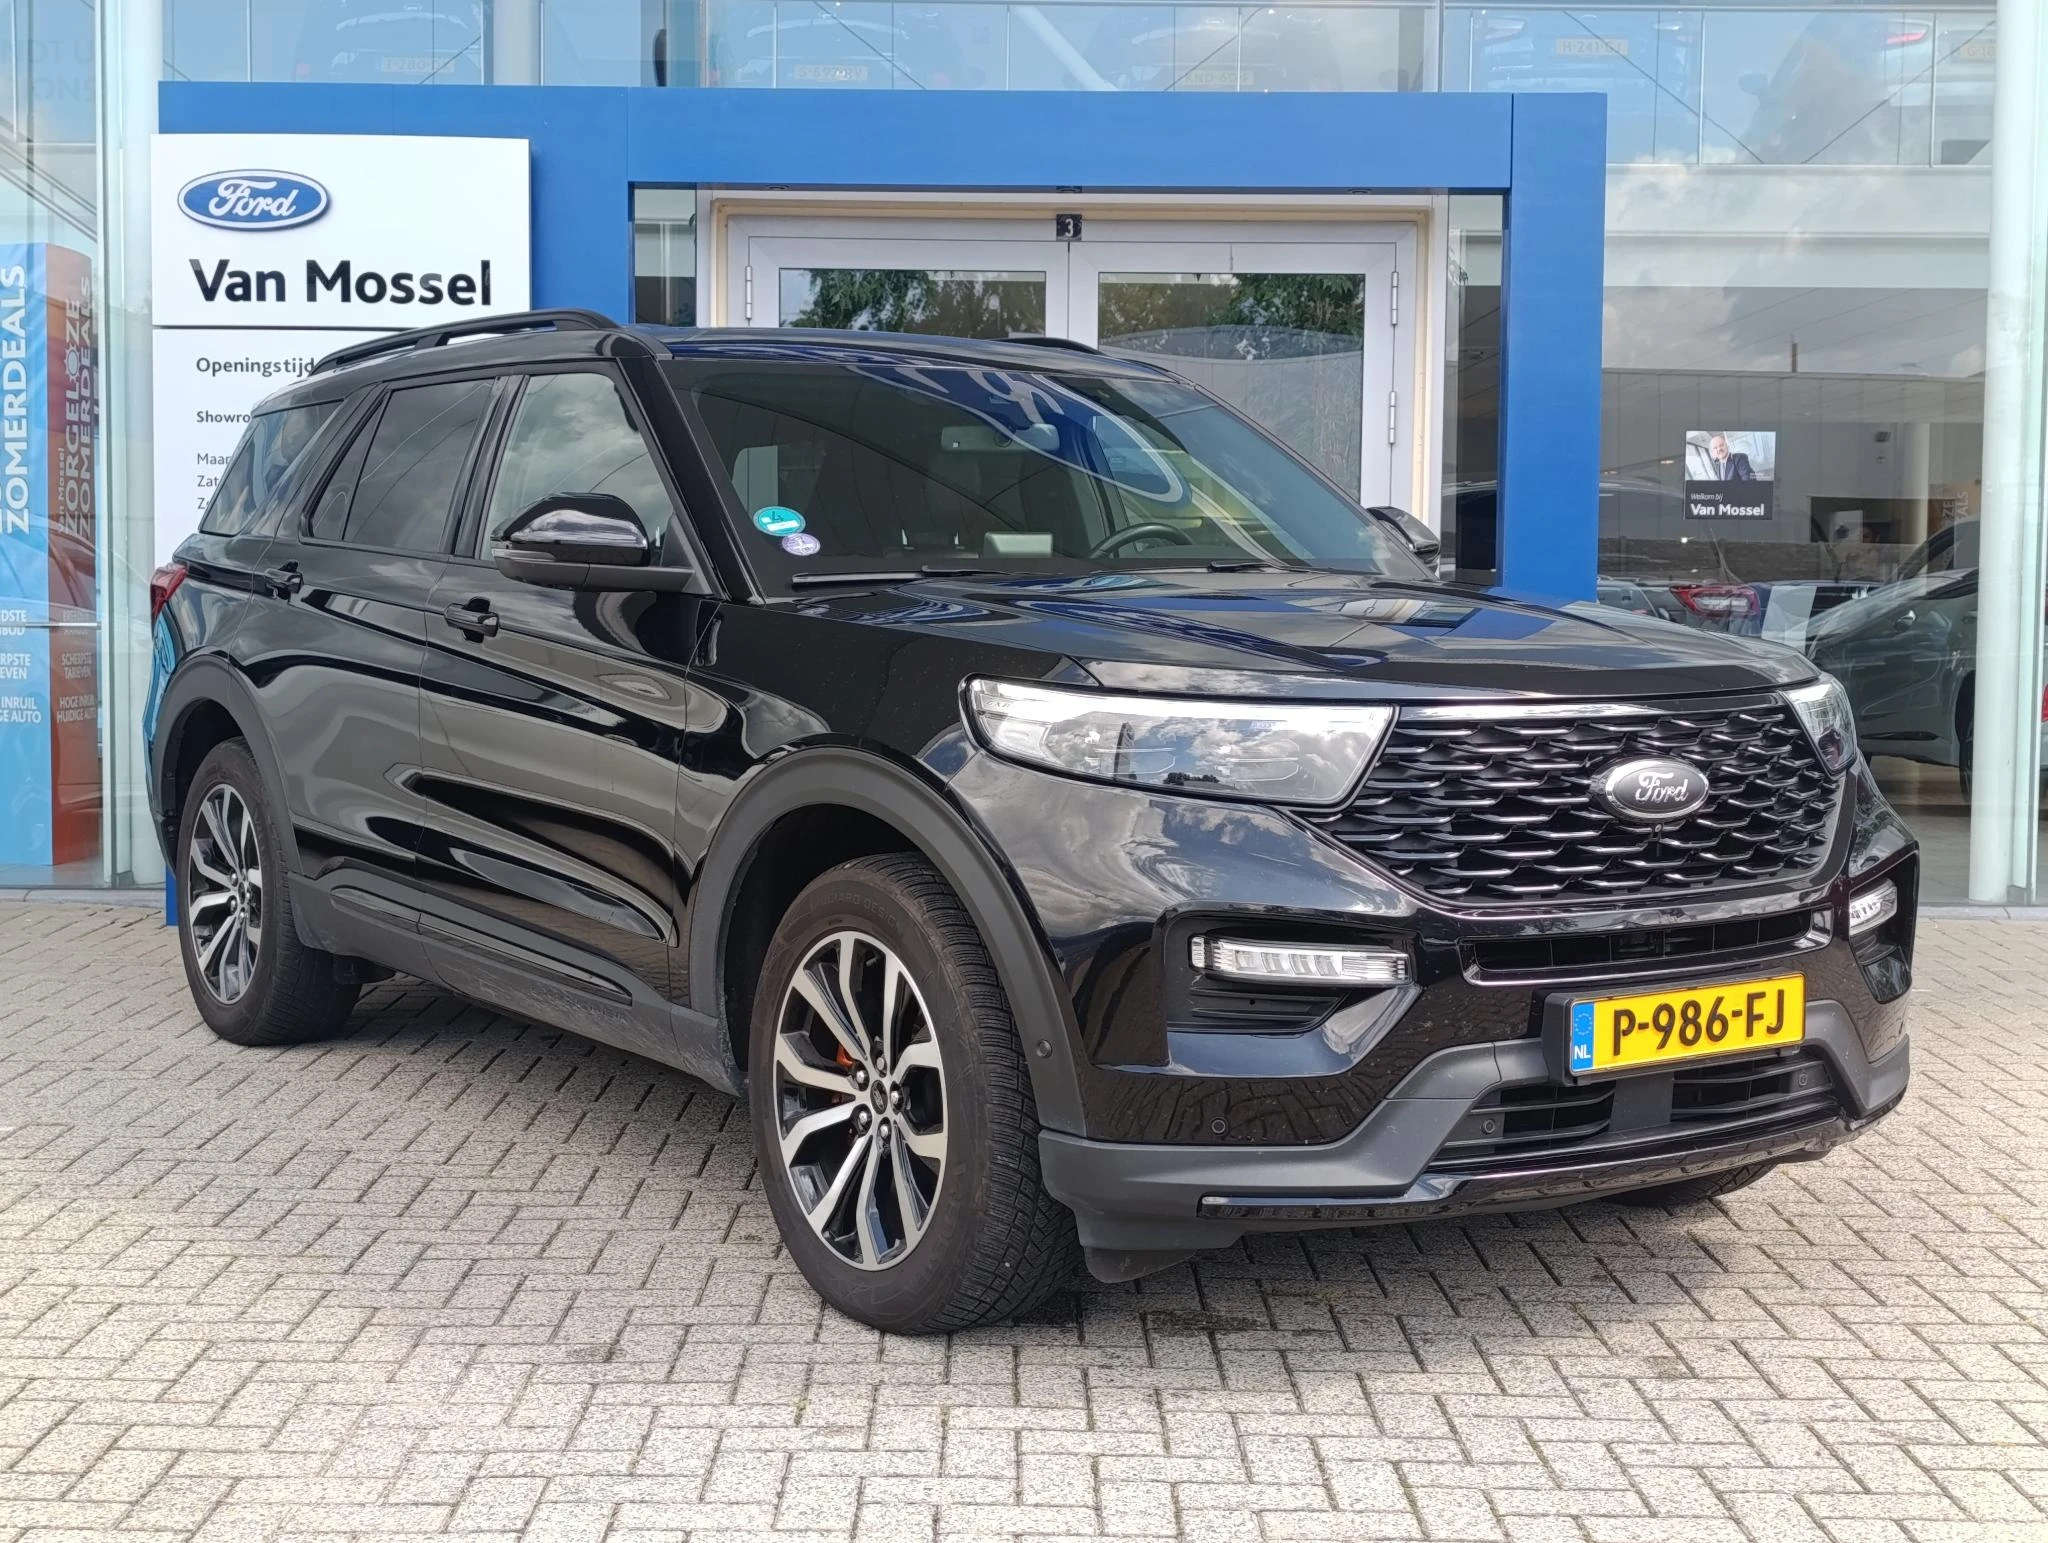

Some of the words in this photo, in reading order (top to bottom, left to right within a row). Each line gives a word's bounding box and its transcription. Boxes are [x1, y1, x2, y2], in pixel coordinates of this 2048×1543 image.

[208, 178, 299, 217] Ford
[1064, 218, 1074, 237] 3
[188, 258, 286, 302] Van
[306, 259, 491, 306] Mossel
[196, 357, 314, 377] Openingstijd
[2, 264, 30, 536] ZOMERDEALS
[79, 276, 92, 538] ZOMERDEALS
[196, 410, 251, 423] Showro
[1690, 503, 1715, 516] Van
[1718, 503, 1765, 516] Mossel
[10, 709, 42, 723] AUTO
[1635, 771, 1689, 803] Ford
[1612, 988, 1786, 1057] P-986-FJ
[1574, 1045, 1592, 1059] NL
